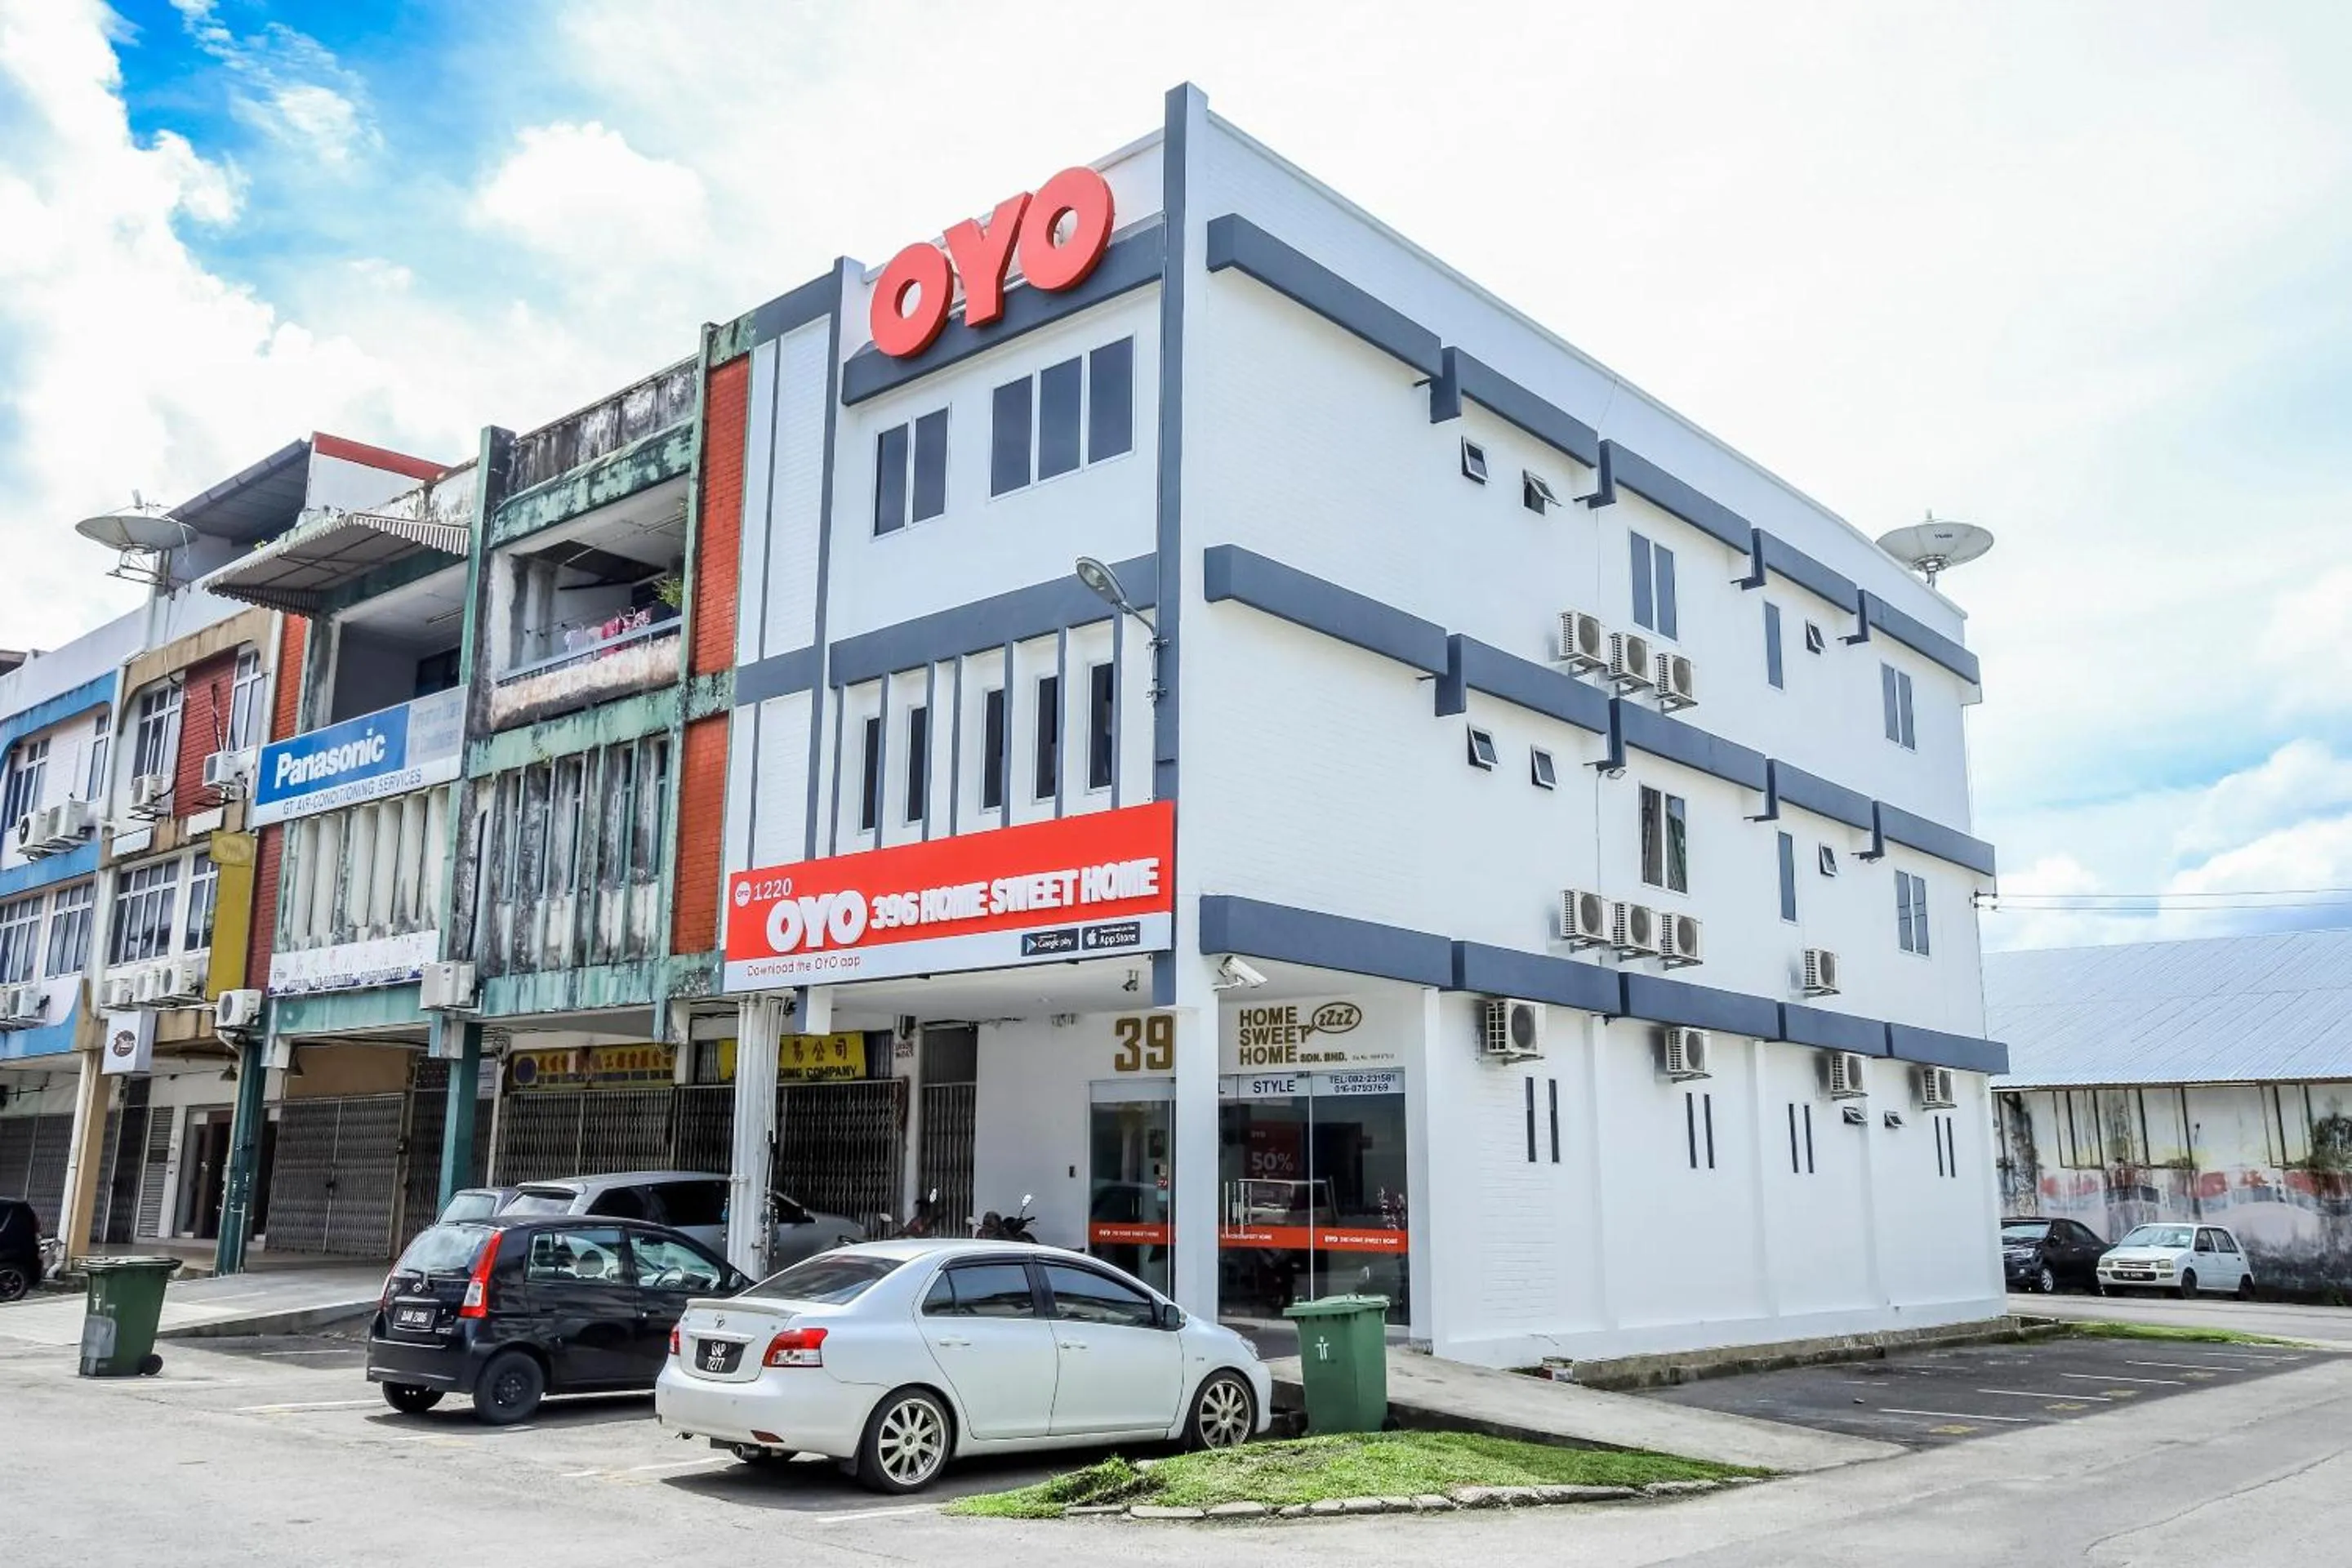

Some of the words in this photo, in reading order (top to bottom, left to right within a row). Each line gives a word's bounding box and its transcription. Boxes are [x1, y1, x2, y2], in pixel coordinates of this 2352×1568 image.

[870, 165, 1115, 358] OYO
[274, 728, 385, 789] Panasonic
[283, 802, 294, 815] GT
[296, 781, 376, 811] AIR-CONDITIONING
[378, 768, 422, 792] SERVICES
[753, 877, 792, 901] 1220
[766, 889, 868, 953] OYO
[870, 892, 920, 929] 396
[920, 882, 989, 924] HOME
[989, 869, 1080, 915] SWEET
[1080, 858, 1160, 904] HOME
[1037, 938, 1059, 949] Google
[1099, 935, 1116, 947] App
[1116, 932, 1136, 943] Store
[746, 962, 794, 977] Download
[796, 960, 811, 973] the
[814, 956, 838, 970] OYO
[840, 956, 860, 968] app
[1240, 1006, 1297, 1027] HOME
[1114, 1015, 1174, 1071] 39
[1240, 1025, 1307, 1046] SWEET
[1240, 1045, 1297, 1066] HOME
[1324, 1052, 1348, 1062] BHD.
[806, 1065, 858, 1078] COMPANY
[1254, 1080, 1296, 1094] STYLE
[1251, 1152, 1294, 1171] 50%
